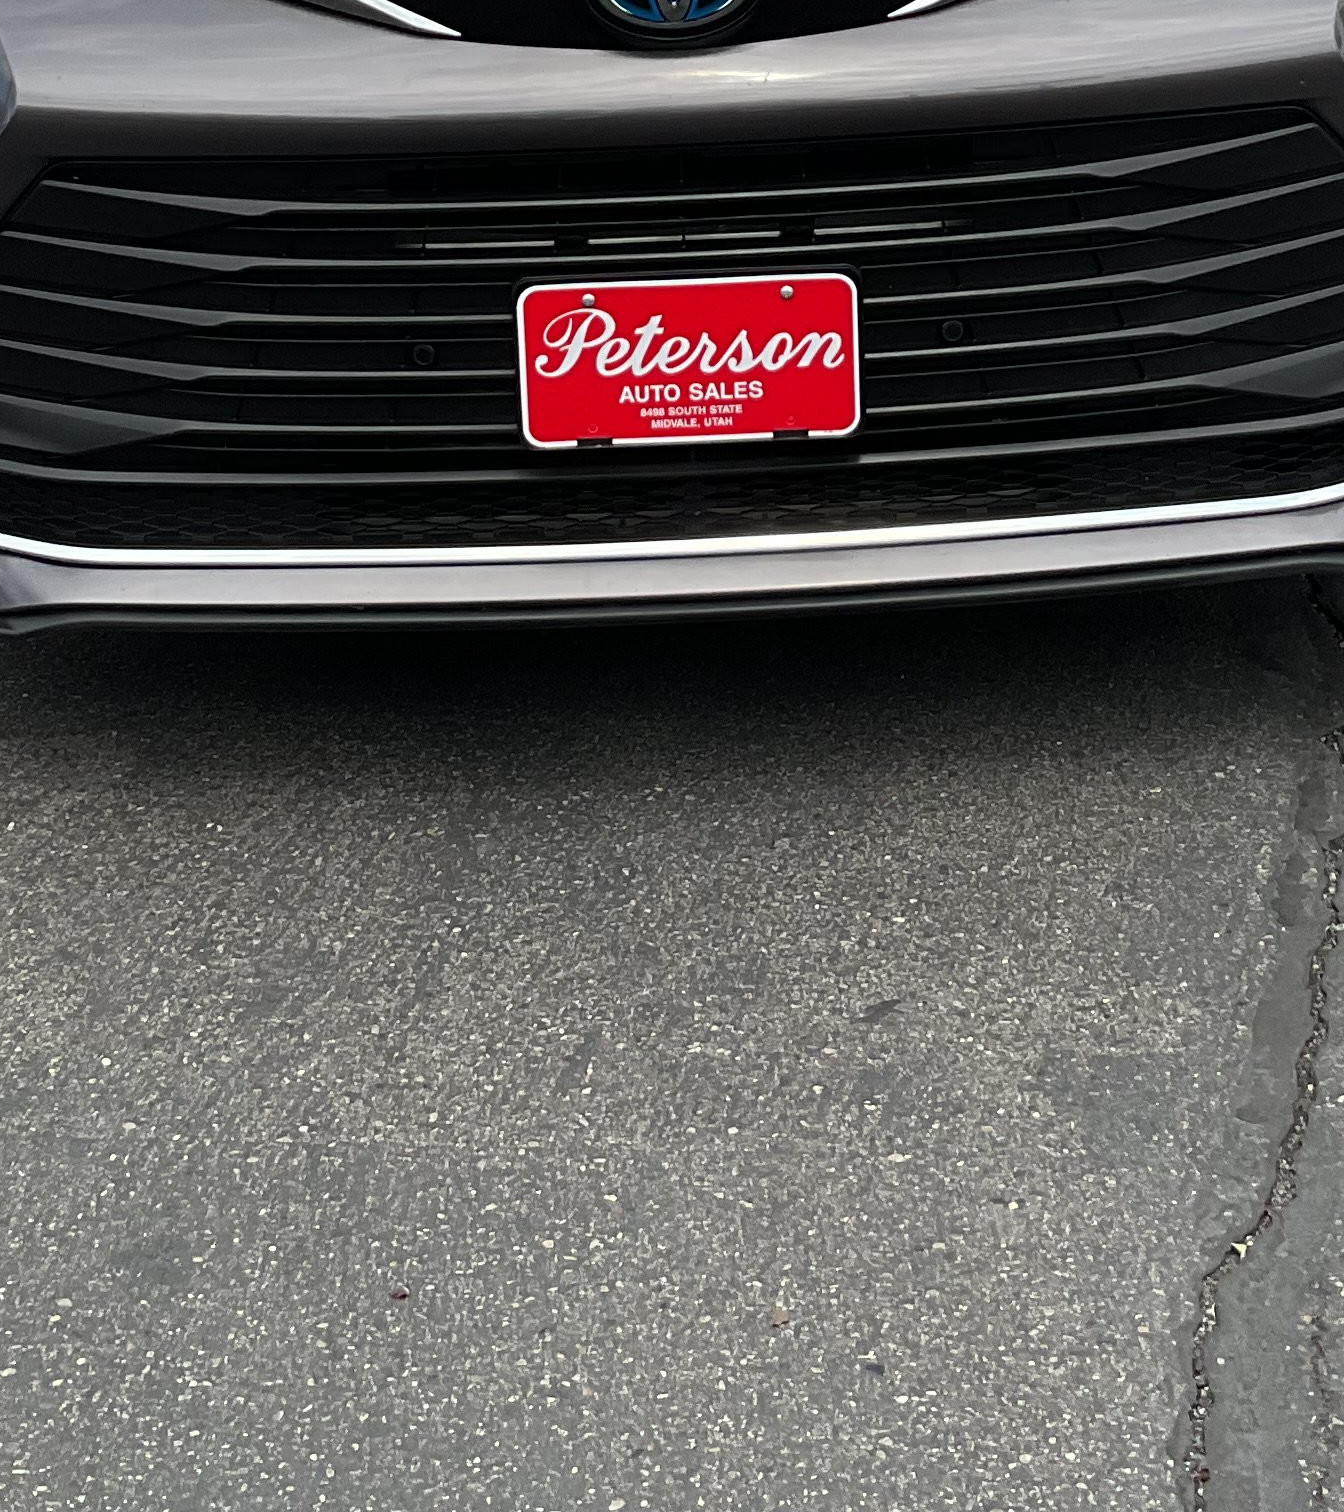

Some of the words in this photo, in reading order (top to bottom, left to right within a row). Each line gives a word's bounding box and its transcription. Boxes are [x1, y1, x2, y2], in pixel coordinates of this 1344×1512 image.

[534, 307, 845, 377] Peterson
[619, 384, 681, 404] AUTO
[688, 380, 764, 401] SALES
[668, 405, 707, 416] SOUTH
[709, 404, 743, 414] STATE
[651, 419, 701, 429] MIDVALE,
[703, 417, 733, 427] UTAH
